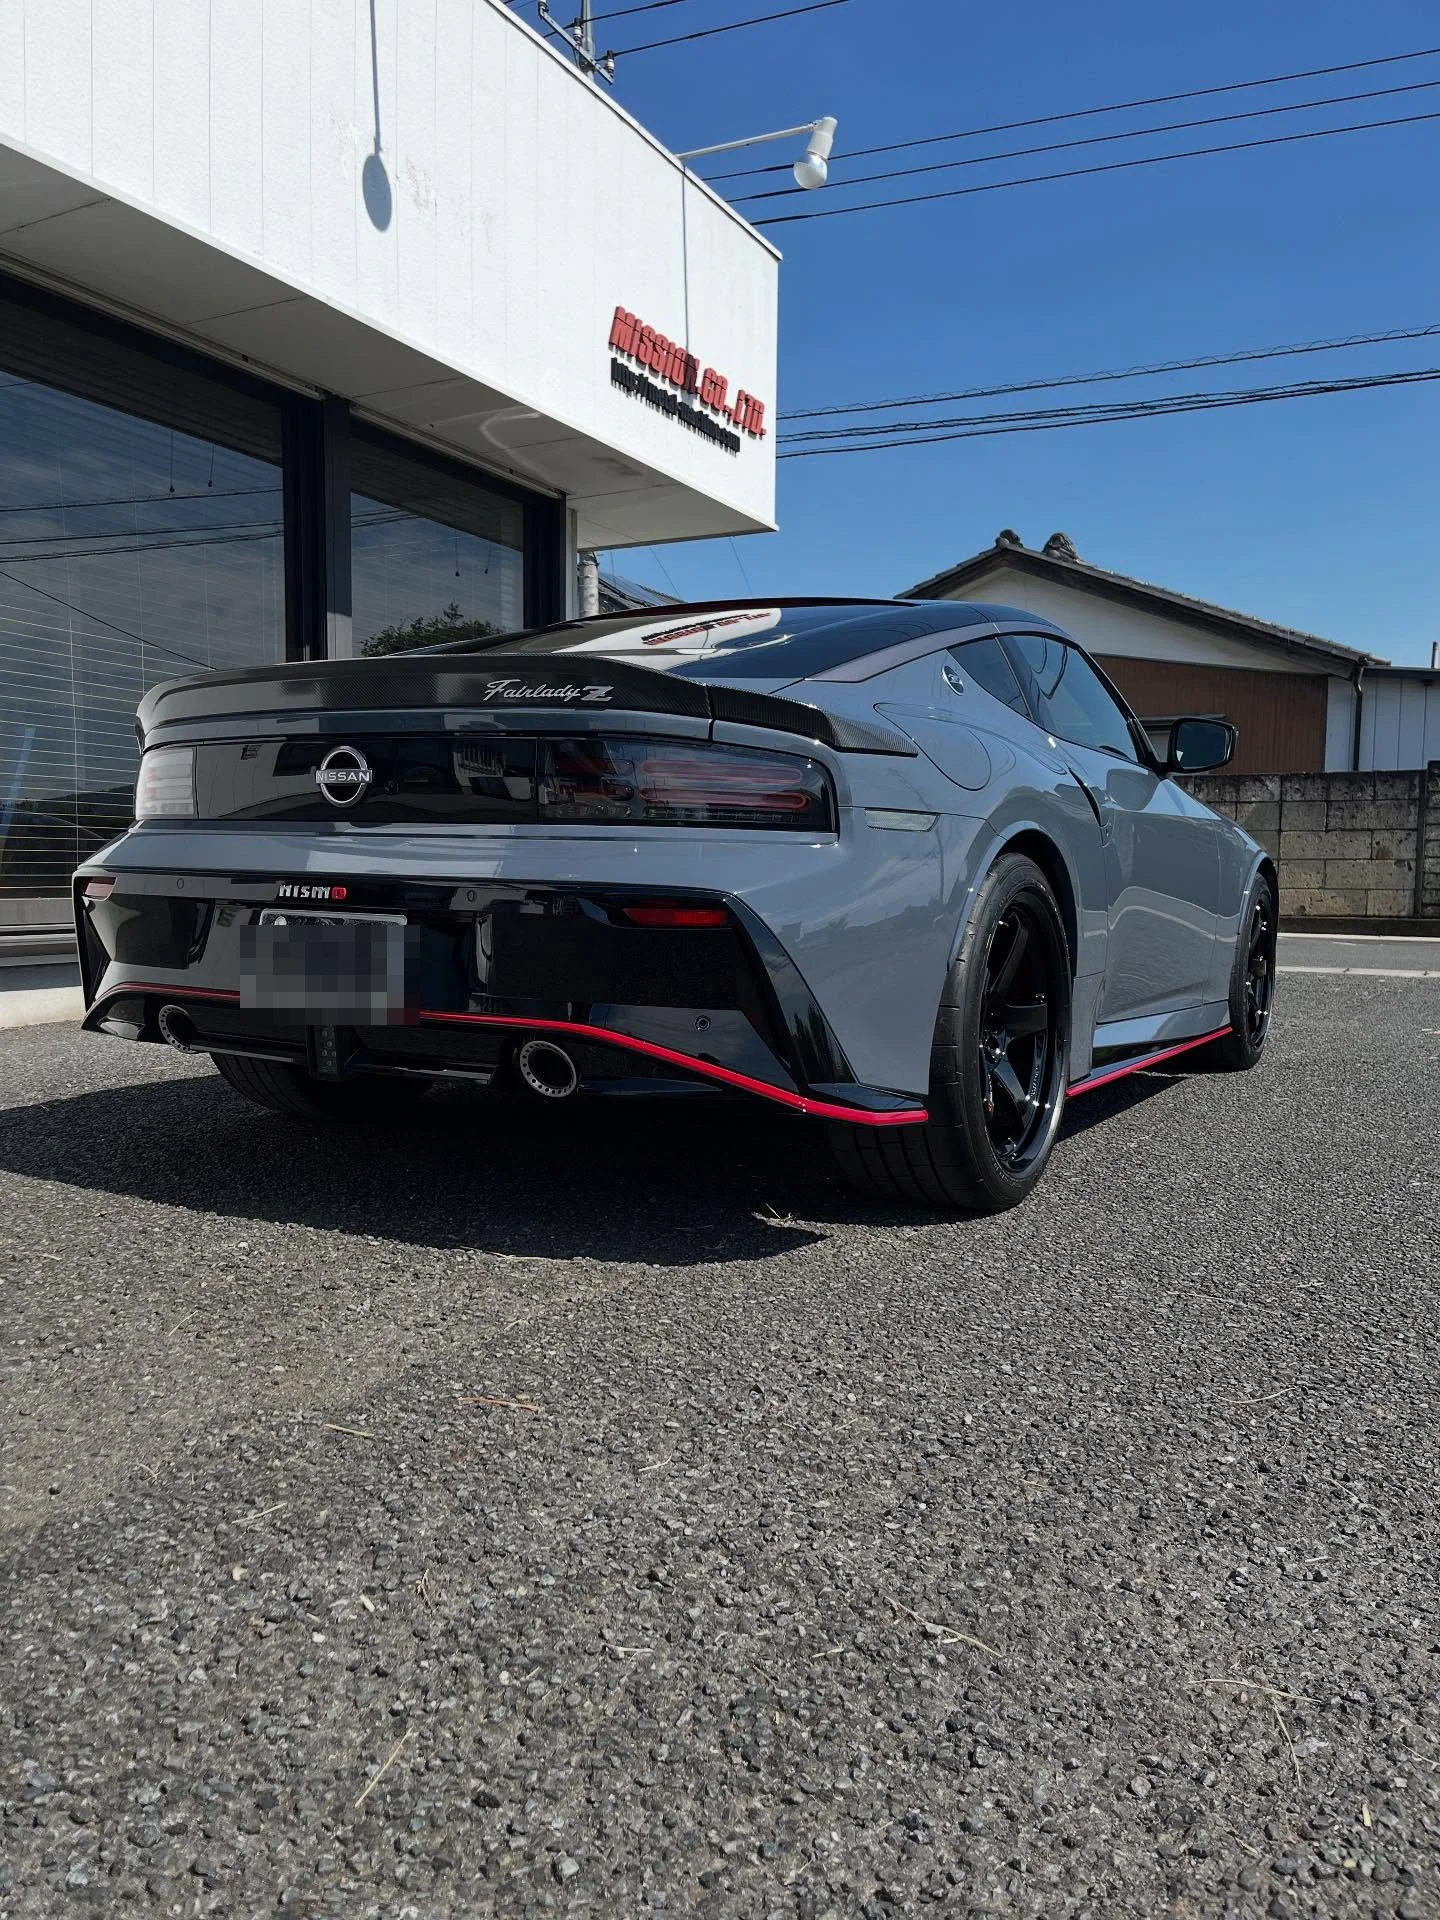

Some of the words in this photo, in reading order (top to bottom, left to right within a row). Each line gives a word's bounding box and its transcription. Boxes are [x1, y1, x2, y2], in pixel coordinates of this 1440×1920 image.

[483, 679, 581, 701] Fairlady
[581, 685, 614, 702] Z
[317, 771, 370, 782] NISSAN
